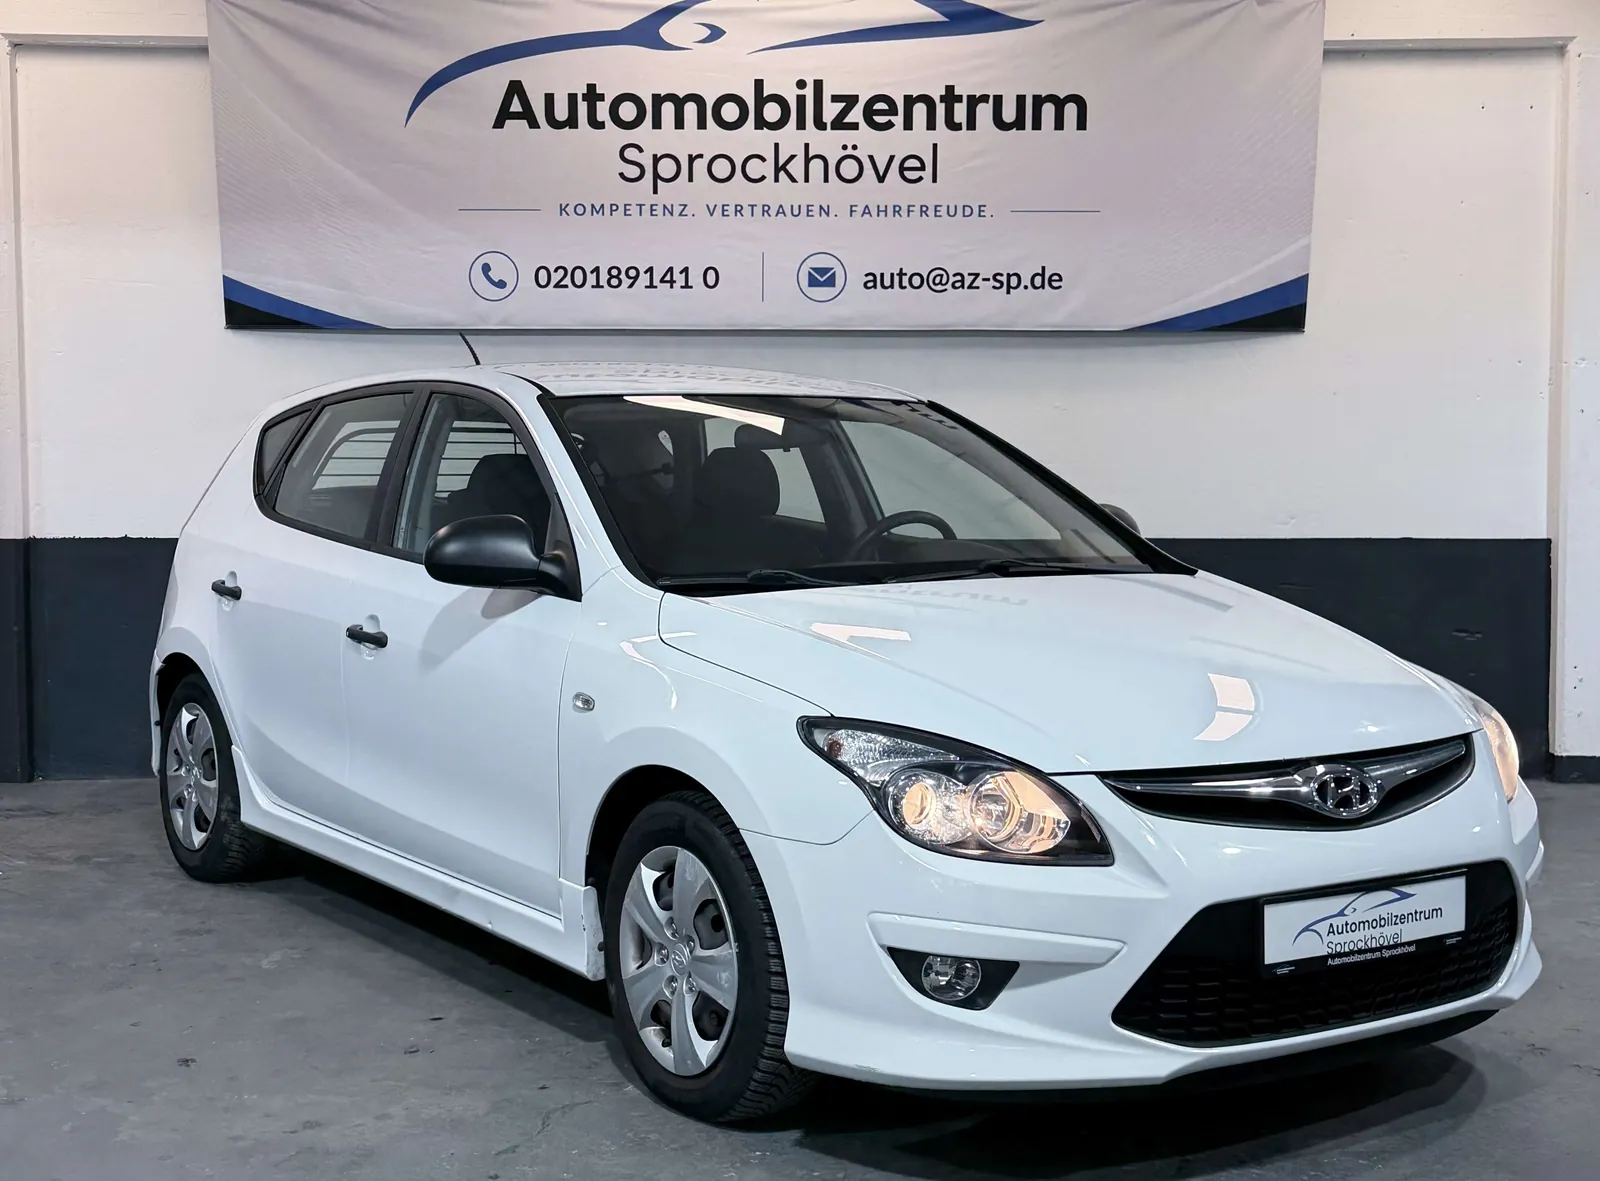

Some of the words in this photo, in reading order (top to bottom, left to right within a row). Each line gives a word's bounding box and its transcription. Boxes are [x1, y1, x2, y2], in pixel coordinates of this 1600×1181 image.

[491, 78, 1088, 132] Automobilzentrum
[617, 142, 938, 195] Sprockhövel
[558, 202, 696, 218] KOMPETENZ.
[705, 202, 838, 218] VERTRAUEN.
[849, 202, 994, 218] FAHRFREUDE.
[862, 265, 1064, 296] auto@az-sp.de
[1326, 907, 1443, 937] Automobilzentrum
[1326, 928, 1403, 955] Sprockhövel
[1327, 950, 1381, 966] Automobilzentrum
[1381, 943, 1416, 958] Sprockhövel
